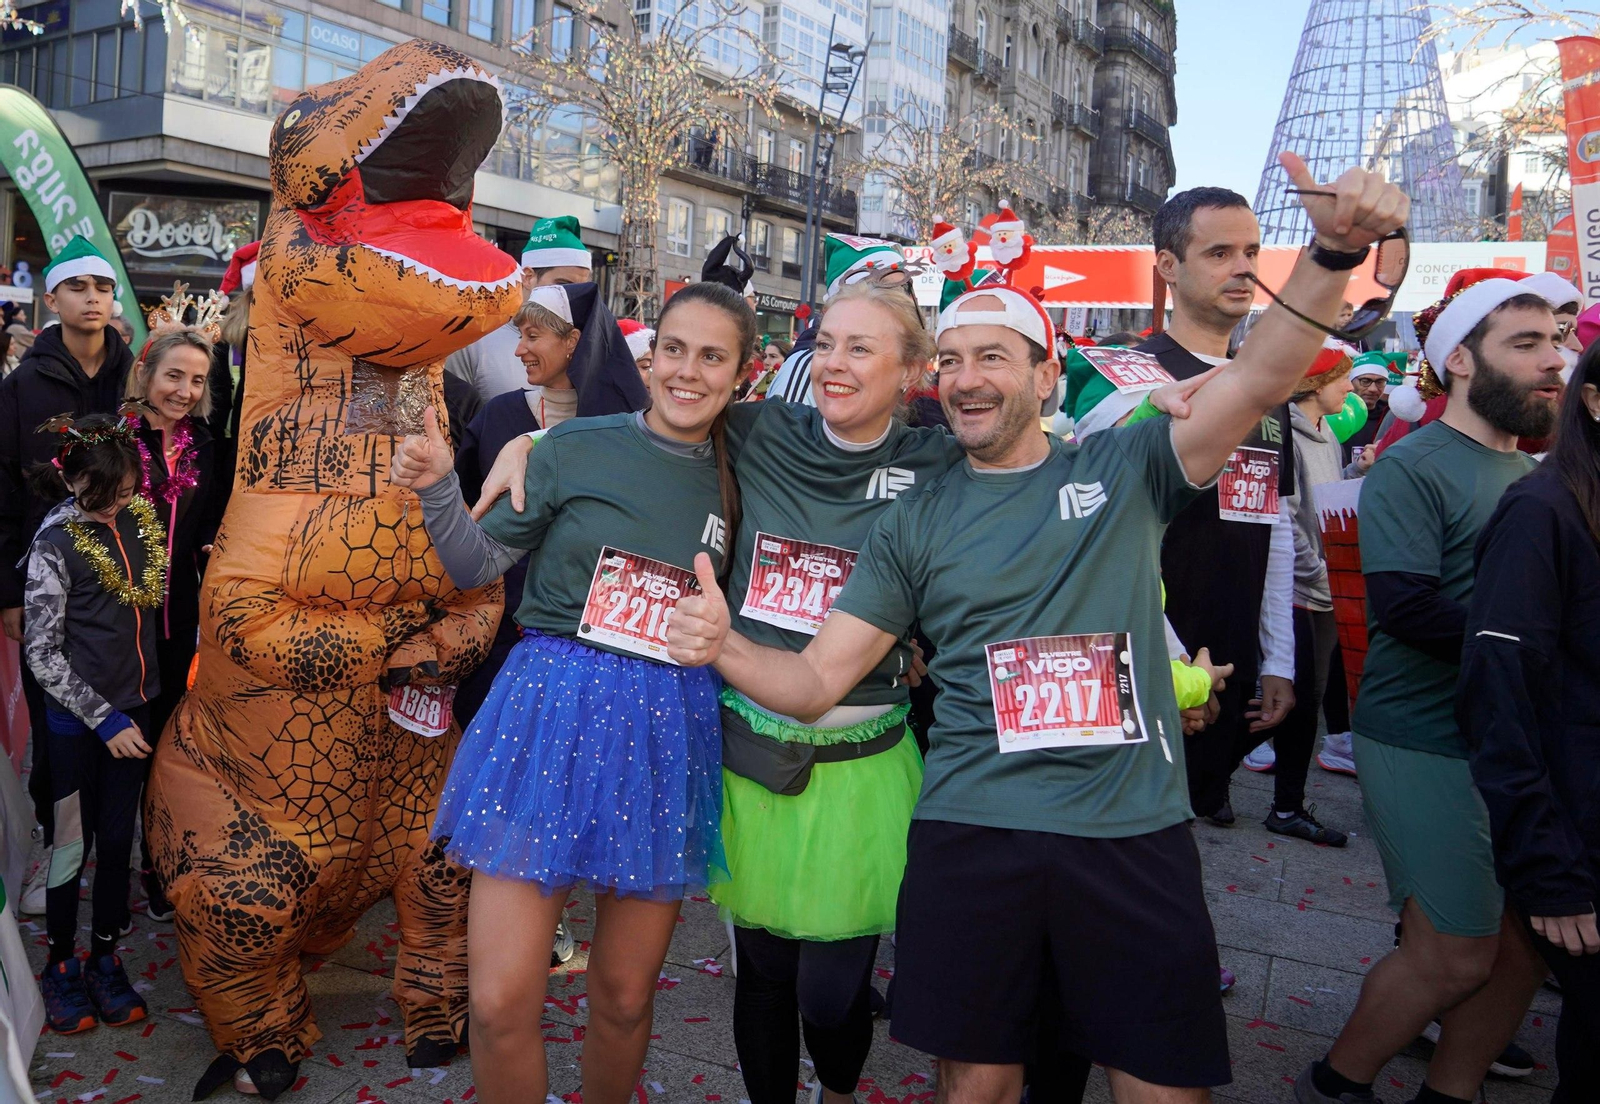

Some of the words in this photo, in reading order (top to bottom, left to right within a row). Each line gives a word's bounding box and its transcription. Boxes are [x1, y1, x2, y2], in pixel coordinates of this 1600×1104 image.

[311, 25, 360, 52] OCASO
[921, 276, 934, 284] DE
[1422, 276, 1439, 285] DE
[760, 295, 770, 307] AS
[770, 296, 799, 311] Computer
[1240, 463, 1271, 479] vigo
[1232, 479, 1267, 510] 336
[788, 556, 842, 579] vigo
[630, 573, 681, 600] vigo
[1038, 650, 1082, 659] SILVESTRE
[1025, 657, 1092, 678] vigo
[1118, 673, 1130, 694] 2217
[399, 685, 441, 727] 1368
[1015, 679, 1102, 727] 2217
